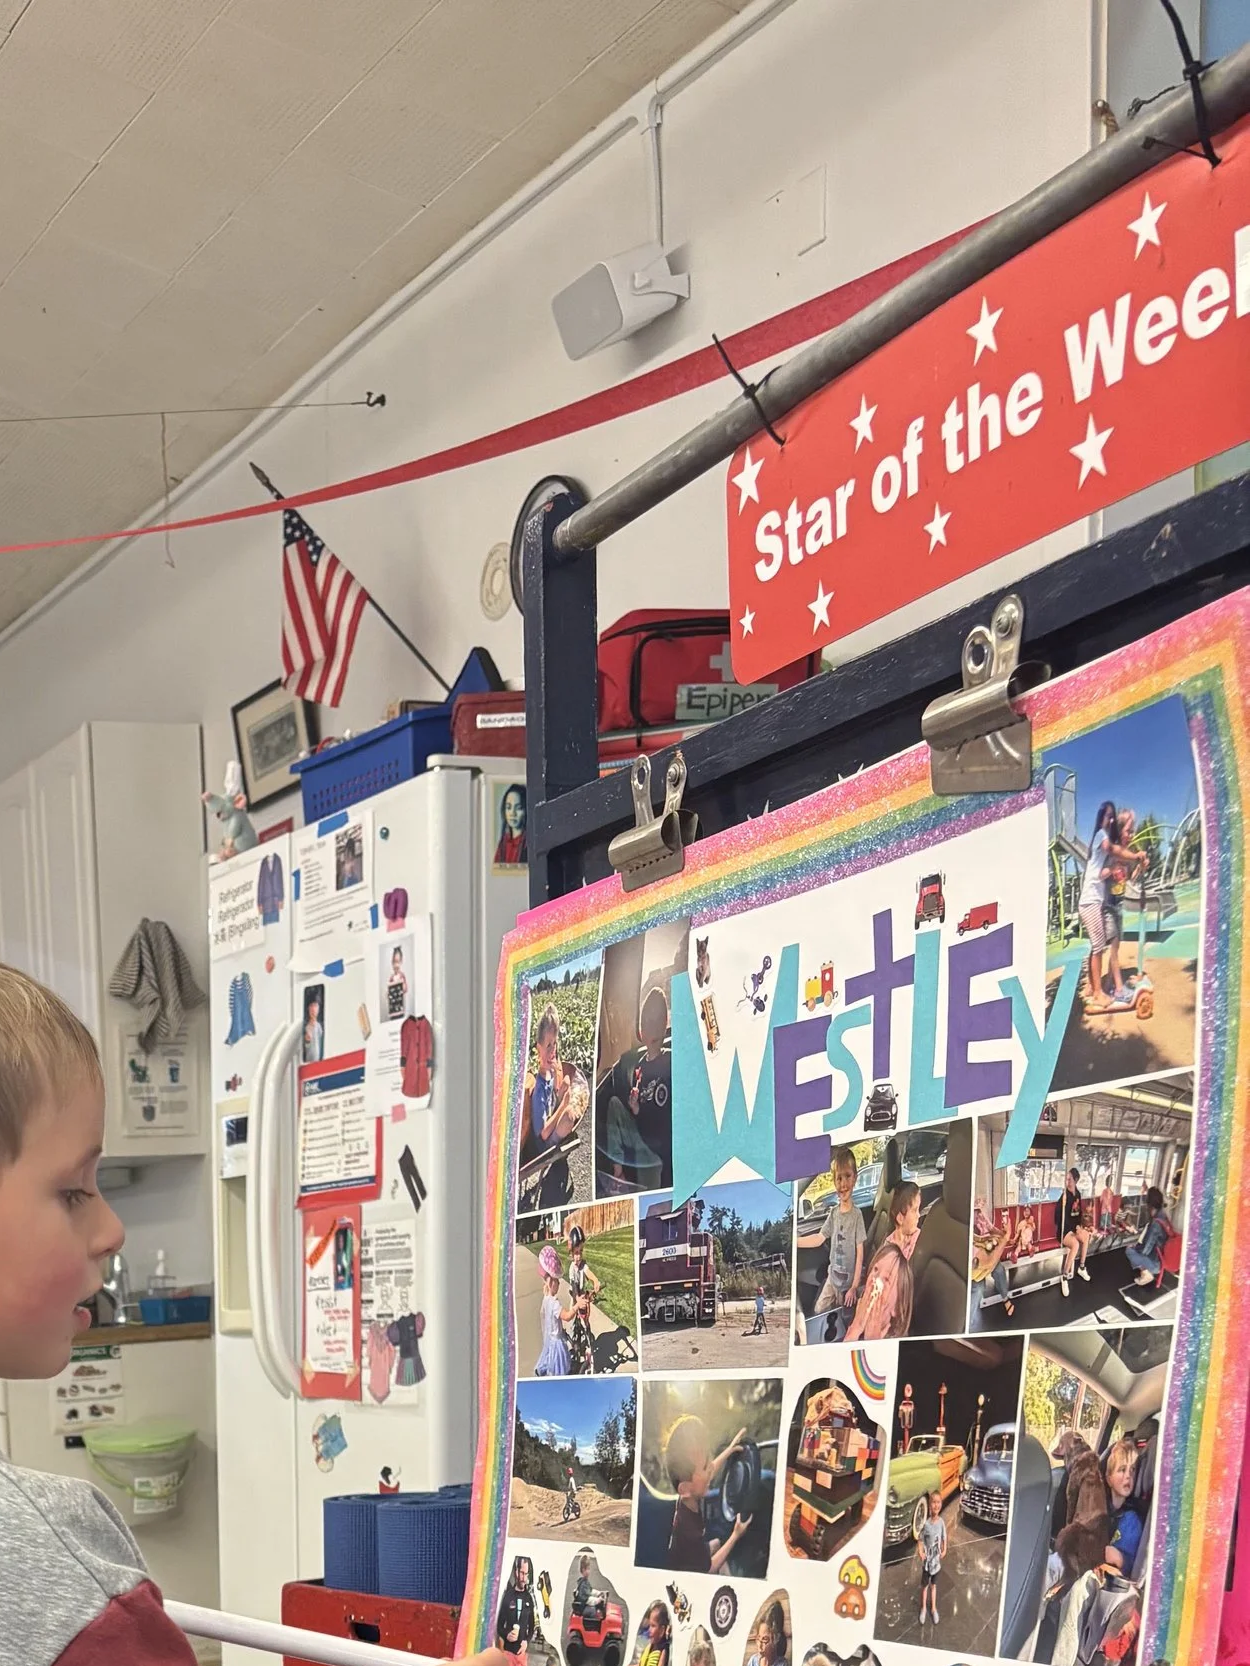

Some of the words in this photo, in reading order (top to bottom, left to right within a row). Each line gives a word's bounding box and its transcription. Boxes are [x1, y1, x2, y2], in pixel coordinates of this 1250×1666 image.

[754, 477, 856, 583] Star
[870, 415, 925, 515] of
[940, 371, 1045, 476] the
